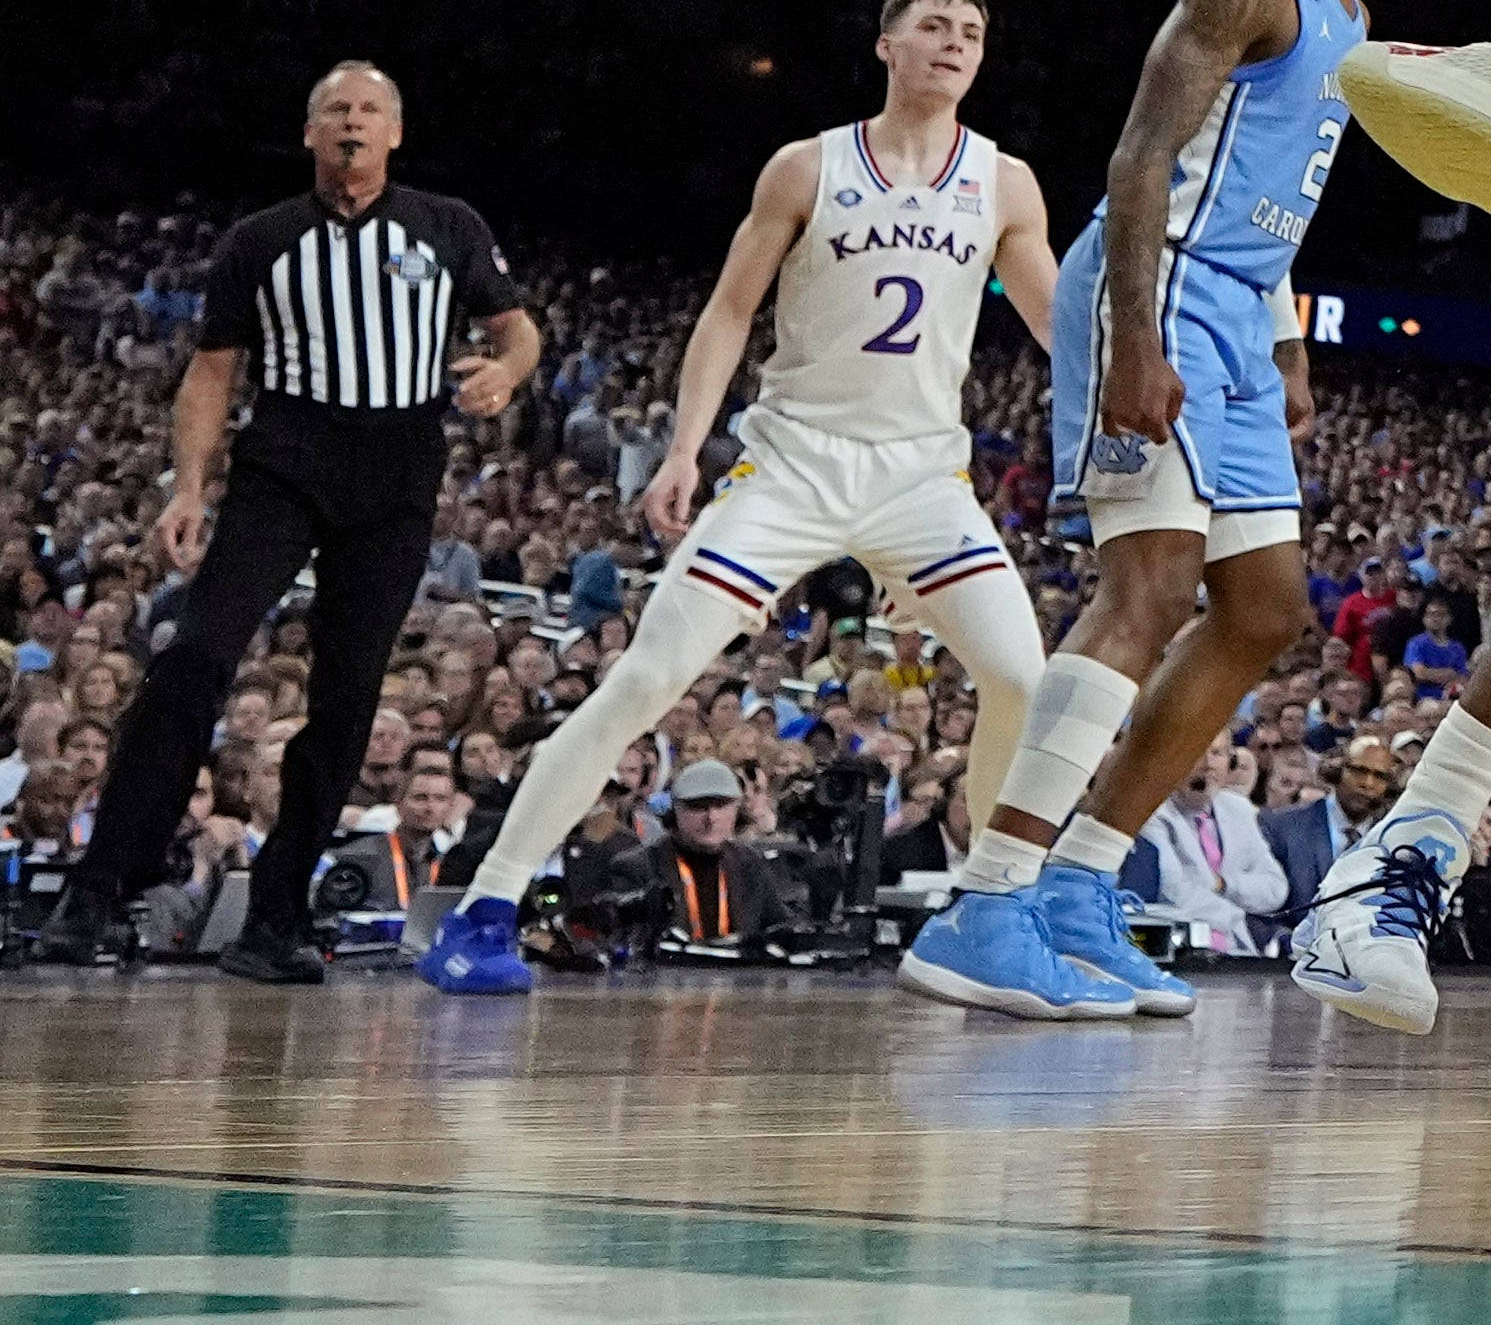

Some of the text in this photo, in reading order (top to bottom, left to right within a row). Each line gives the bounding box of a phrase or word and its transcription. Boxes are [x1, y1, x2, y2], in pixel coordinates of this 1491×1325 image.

[1299, 116, 1343, 204] 2
[828, 222, 978, 266] KANSAS
[860, 275, 925, 355] 2
